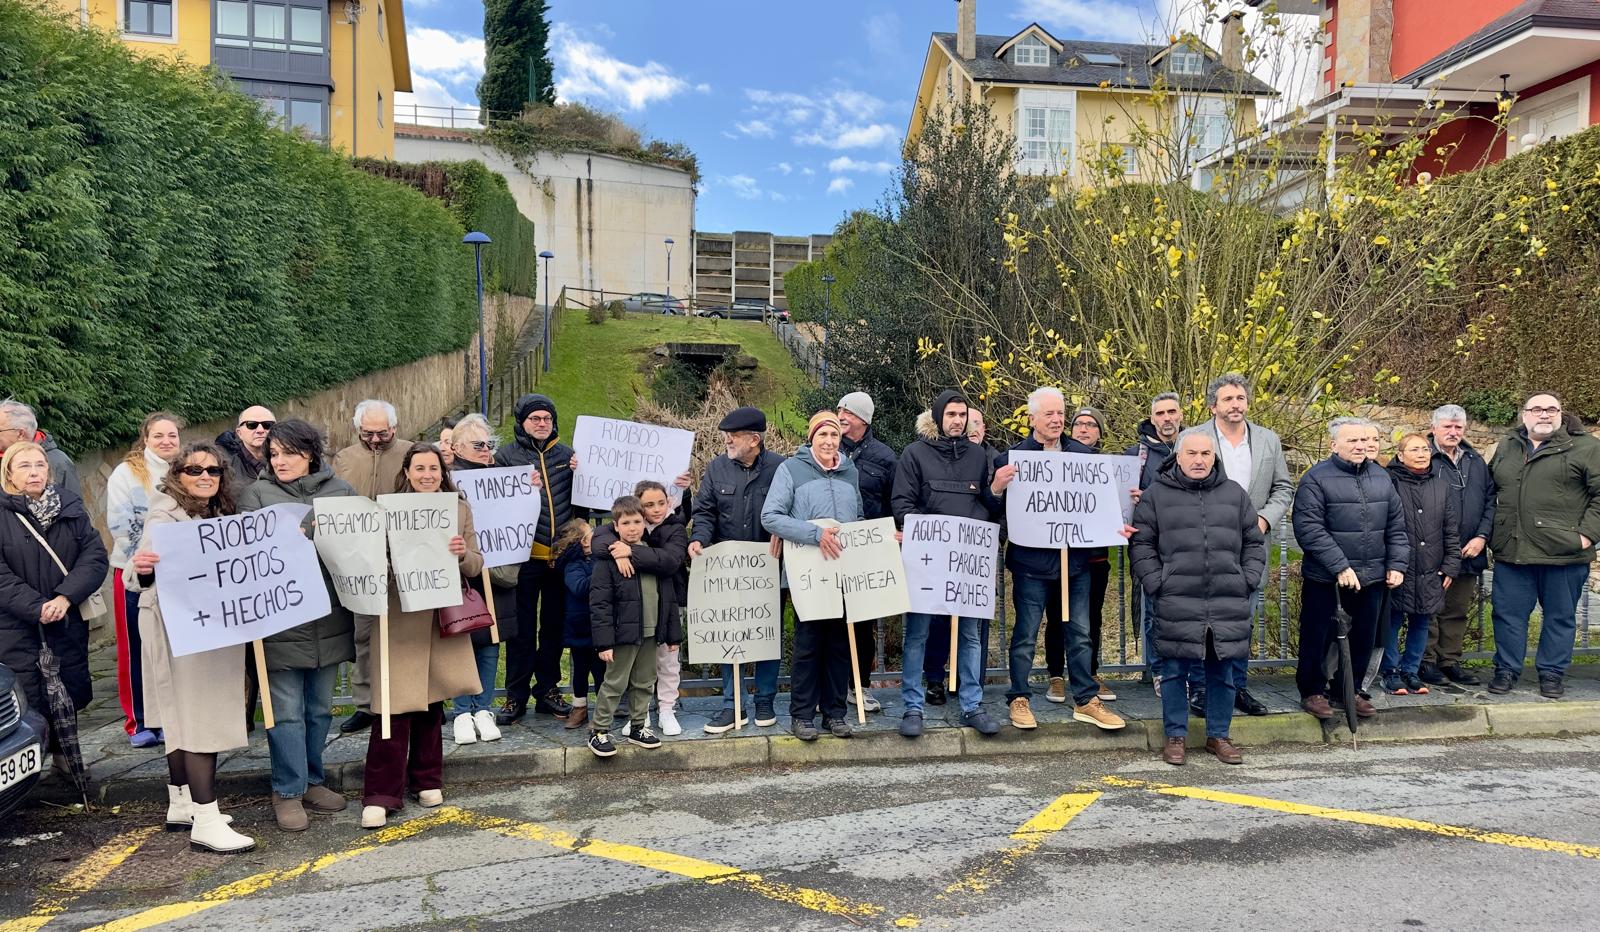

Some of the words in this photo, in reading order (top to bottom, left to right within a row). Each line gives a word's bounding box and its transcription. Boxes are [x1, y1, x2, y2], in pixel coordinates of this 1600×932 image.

[588, 445, 665, 475] PROMETER
[1014, 460, 1053, 483] AGUAS
[1063, 461, 1109, 485] MANSAS
[475, 473, 532, 500] MANSAS
[587, 475, 600, 497] ES
[1026, 491, 1097, 513] ABANDONO
[317, 511, 380, 536] PAGAMOS
[912, 520, 951, 542] AGUAS
[958, 522, 992, 548] MANSAS
[1046, 522, 1094, 544] TOTAL
[839, 527, 883, 550] OMESAS
[216, 546, 285, 588] FOTOS
[705, 553, 767, 572] PAGAMOS
[949, 551, 990, 578] PARQUES
[800, 569, 812, 591] SÍ
[221, 580, 304, 628] HECHOS
[945, 581, 989, 606] BACHES
[721, 645, 747, 659] YA
